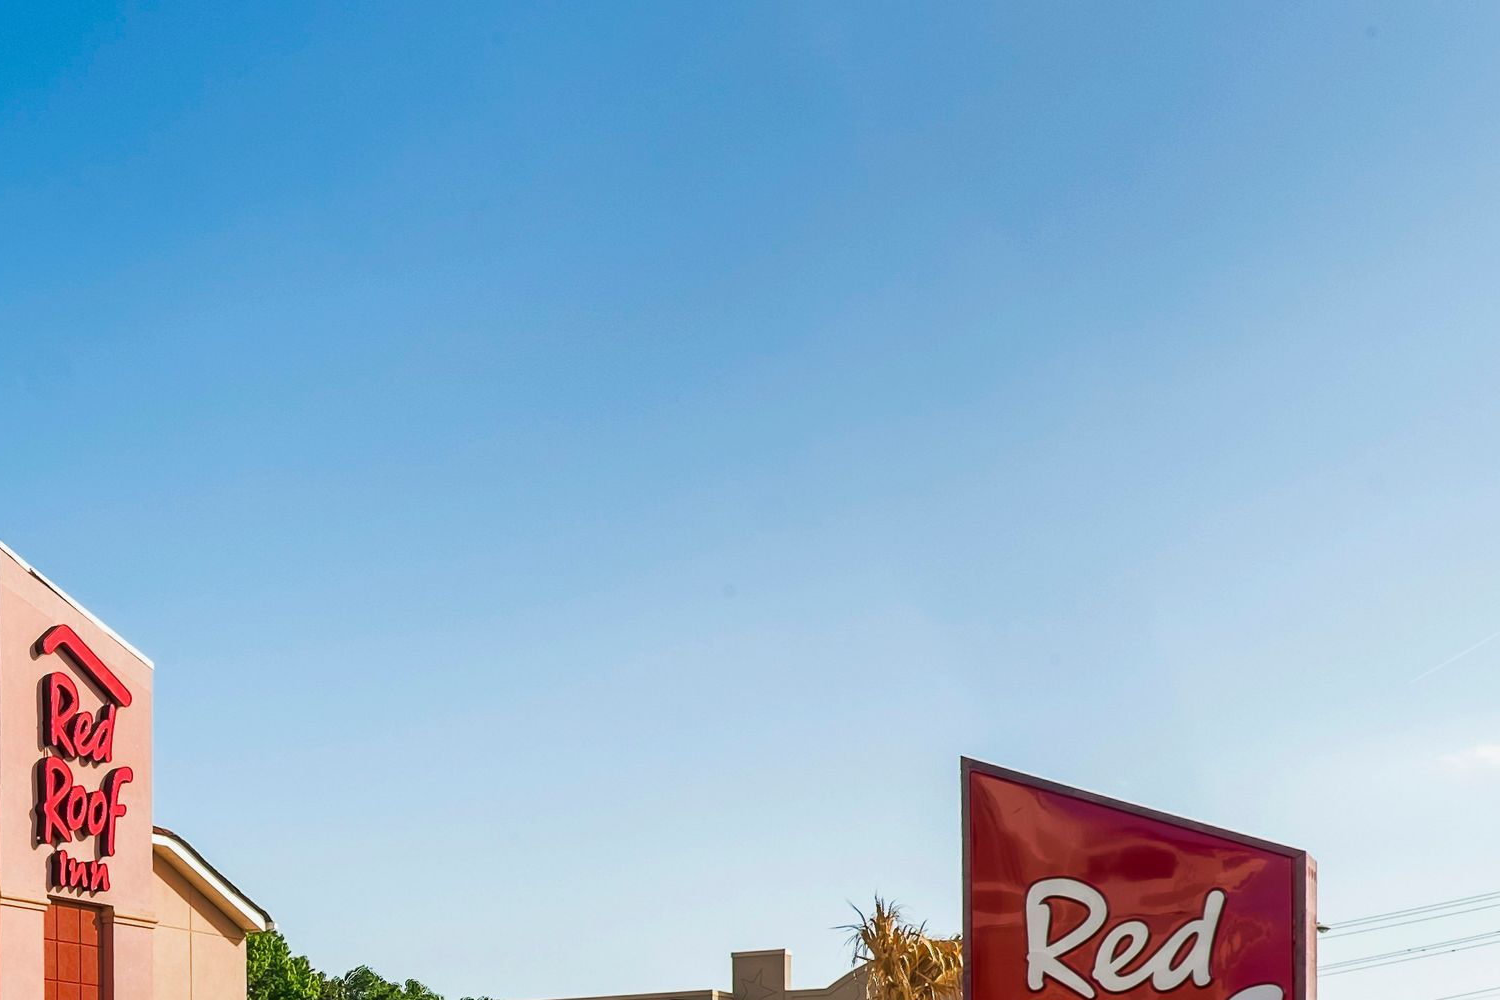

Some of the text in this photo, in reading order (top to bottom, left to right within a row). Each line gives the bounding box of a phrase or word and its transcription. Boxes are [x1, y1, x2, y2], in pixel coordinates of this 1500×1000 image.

[50, 671, 117, 763] Red
[44, 756, 133, 857] Roof
[59, 849, 110, 891] Inn
[1025, 877, 1226, 1000] Red
